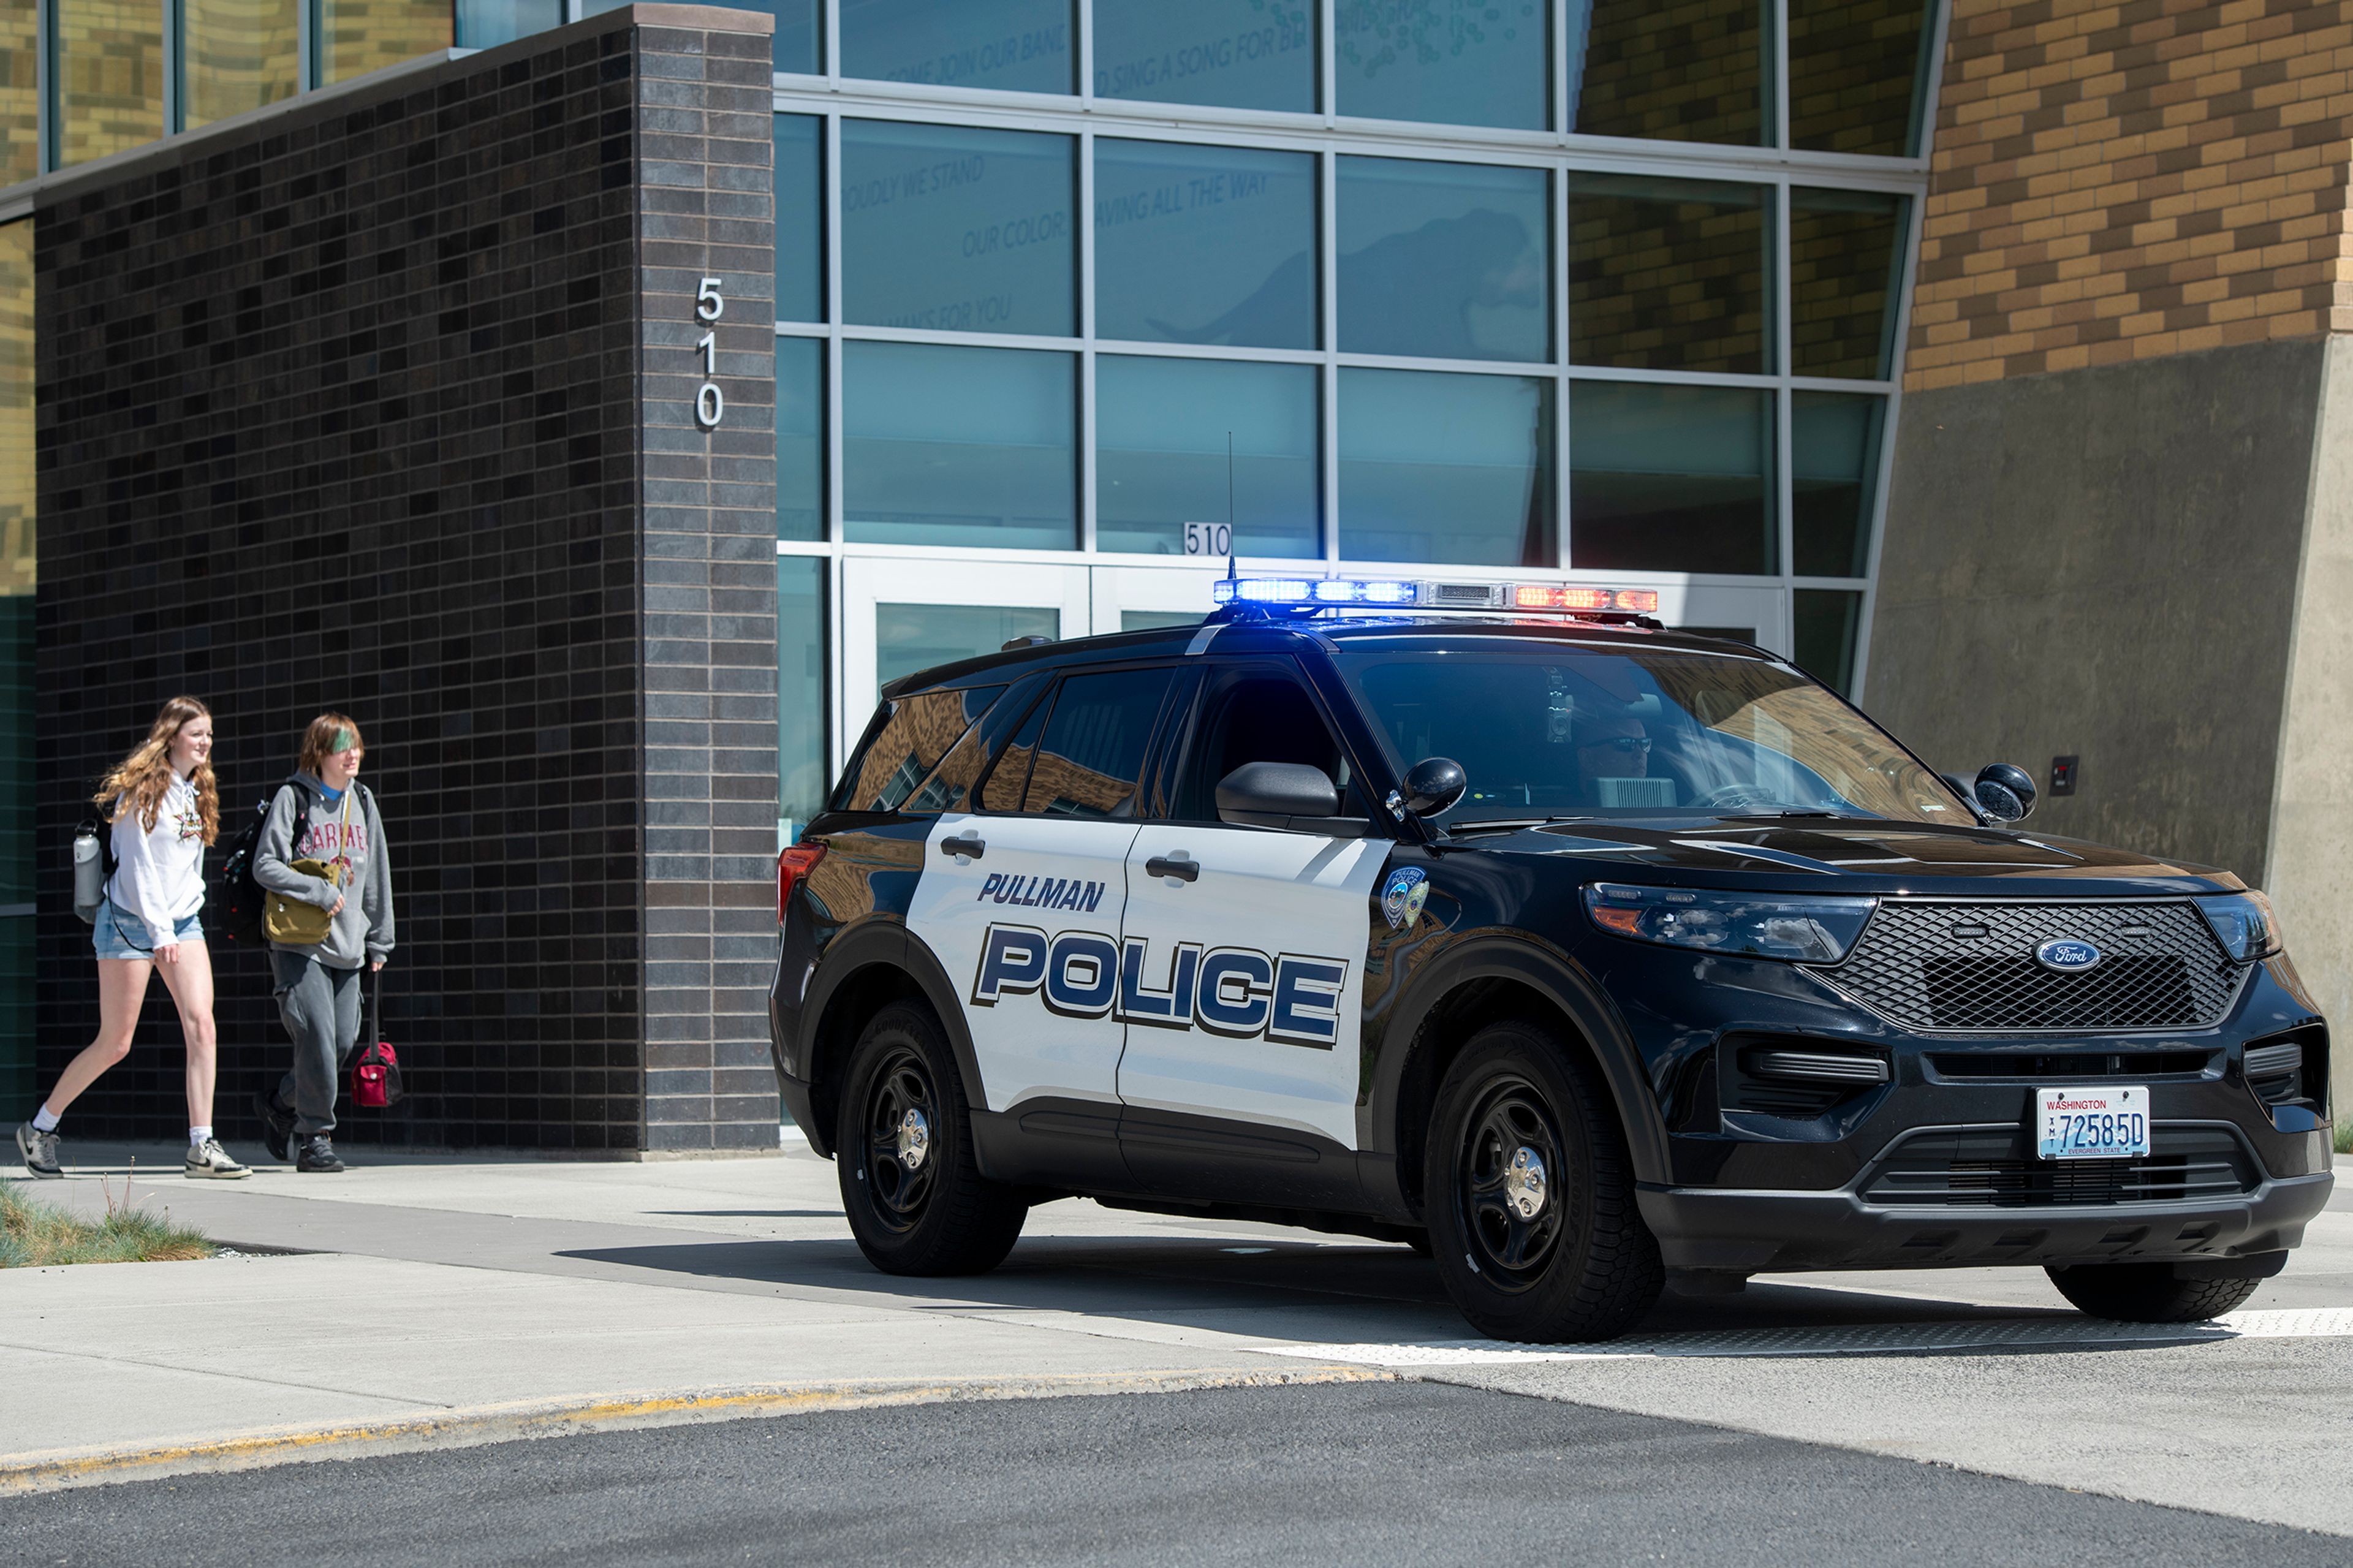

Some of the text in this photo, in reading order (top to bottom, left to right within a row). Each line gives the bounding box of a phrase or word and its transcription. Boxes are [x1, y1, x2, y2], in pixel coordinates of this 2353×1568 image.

[980, 36, 1018, 72] OUR
[1113, 57, 1157, 94] SING
[1158, 53, 1173, 83] A
[1176, 38, 1232, 78] SONG
[1235, 28, 1275, 62] FOR
[902, 168, 928, 197] WE
[931, 154, 984, 192] STAND
[962, 224, 1000, 259] OUR
[1094, 191, 1149, 228] AVING
[1150, 184, 1183, 218] ALL
[1187, 172, 1226, 209] THE
[939, 301, 973, 331] FOR
[975, 293, 1014, 325] YOU
[697, 278, 724, 426] 510
[1186, 524, 1230, 556] 510
[977, 873, 1105, 913] PULLMAN
[1392, 874, 1418, 886] POLICE
[2055, 945, 2087, 962] Ford
[969, 921, 1349, 1050] POLICE
[2047, 1100, 2107, 1110] WASHINGTON
[2060, 1113, 2143, 1148] 72585D
